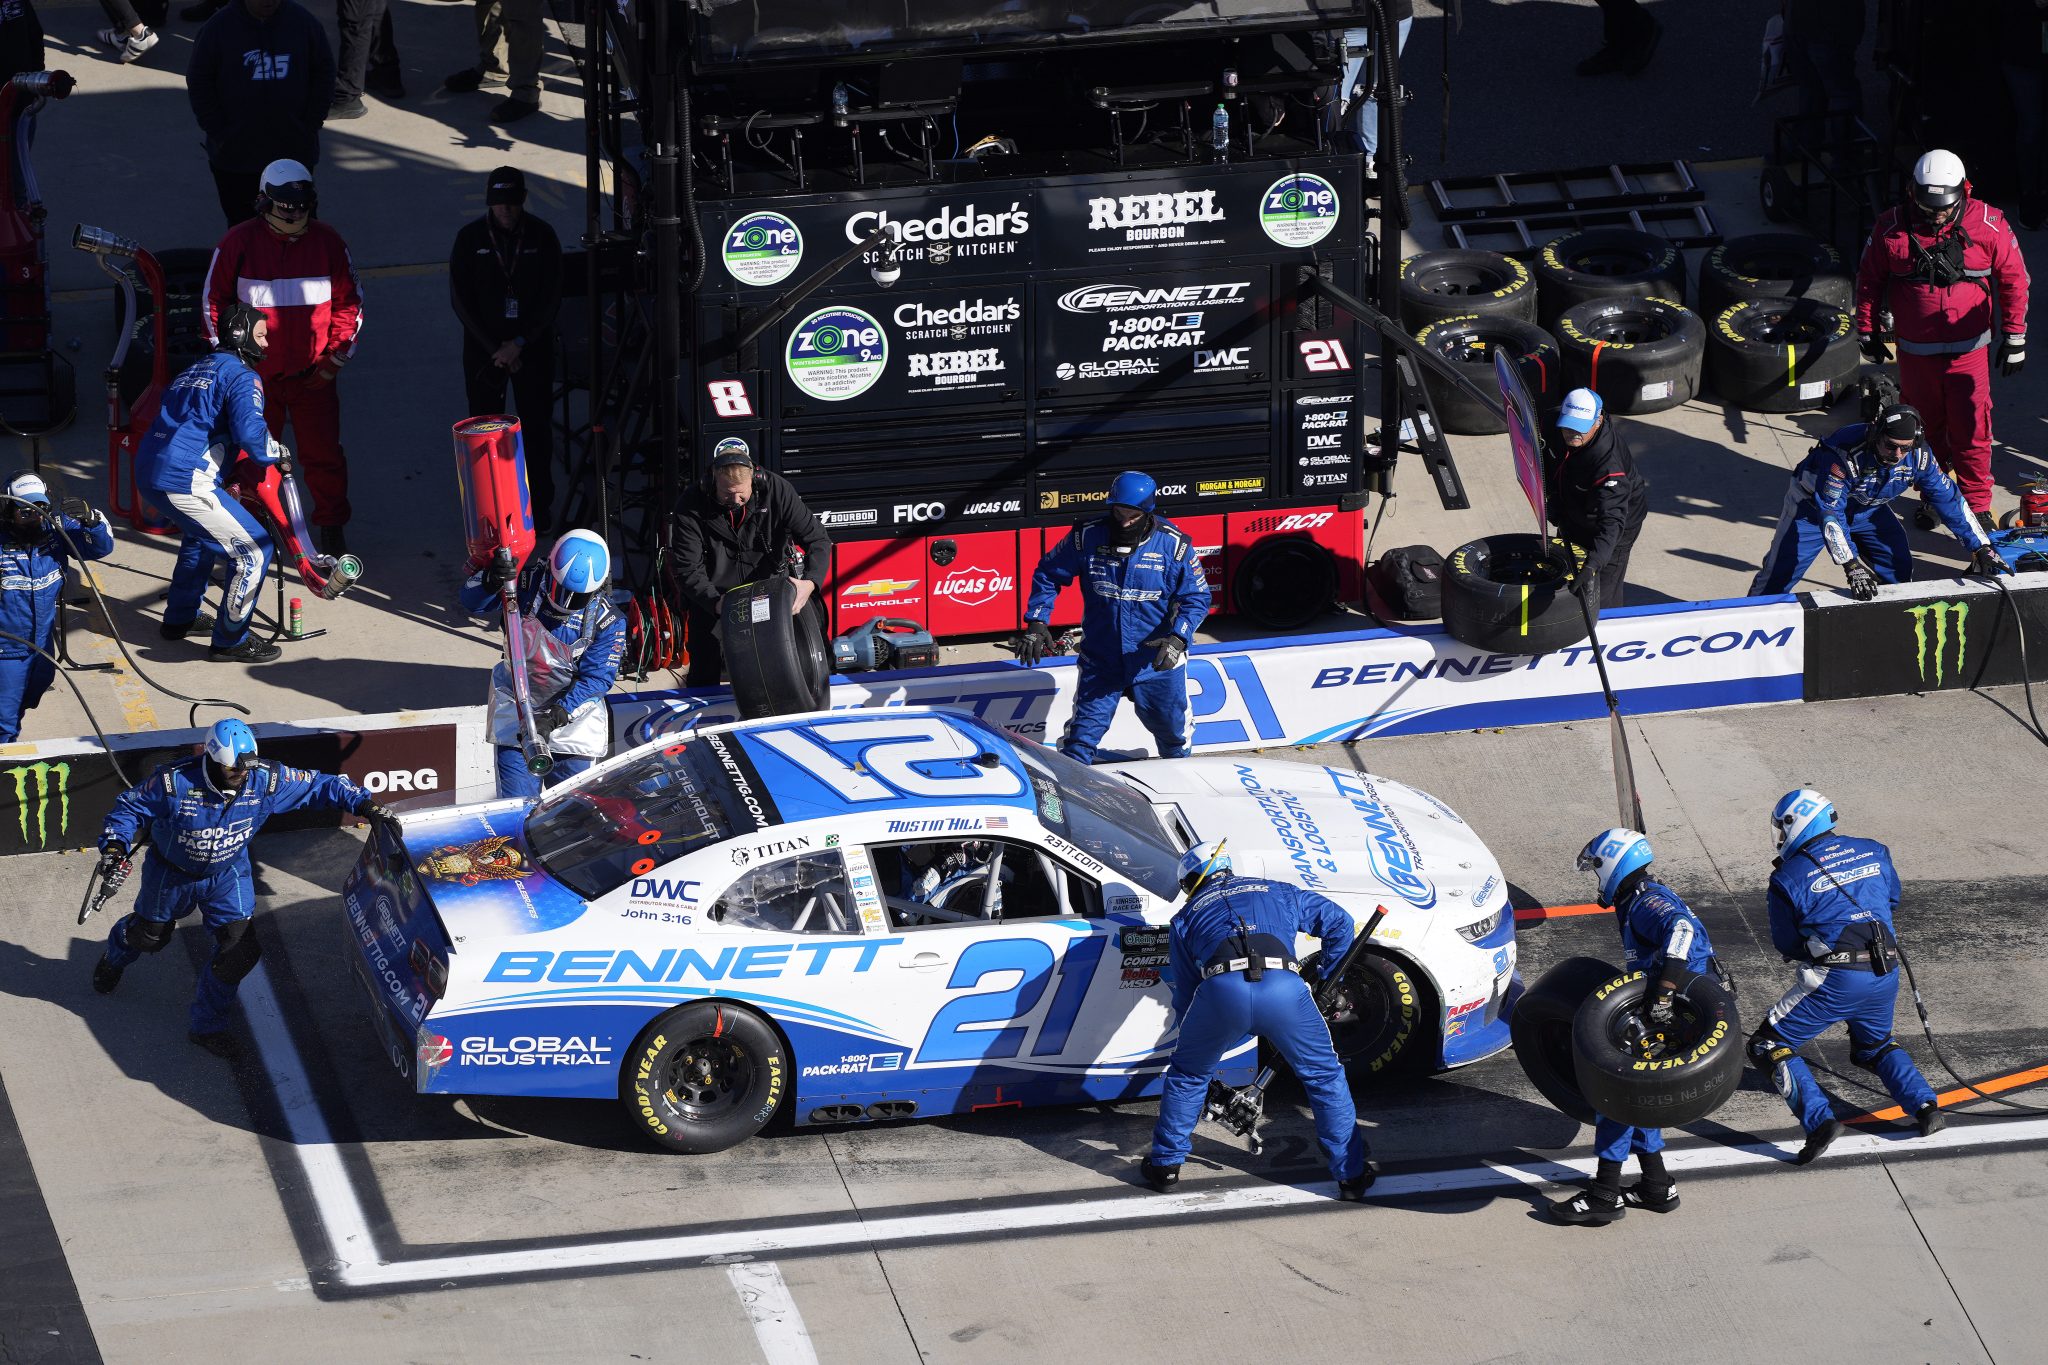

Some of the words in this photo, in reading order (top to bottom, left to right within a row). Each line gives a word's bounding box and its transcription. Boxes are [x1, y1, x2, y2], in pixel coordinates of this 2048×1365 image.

[251, 52, 291, 80] 25
[1089, 189, 1224, 230] REBEL
[845, 202, 1029, 244] Cheddar's
[1126, 226, 1185, 241] BOURBON
[732, 227, 797, 249] zone
[863, 247, 924, 264] SCATCH
[957, 244, 1015, 257] KITCHEN
[22, 266, 31, 279] 3
[1076, 282, 1251, 308] BENNETT
[1105, 301, 1188, 313] TRANSPORTATION
[1196, 297, 1245, 306] LOGISTICS
[894, 297, 1020, 327] Cheddar's
[798, 325, 879, 354] zone
[906, 328, 948, 340] SCRATCH
[970, 324, 1011, 335] KITCHEN
[1102, 330, 1206, 352] PACK-RAT
[908, 347, 1006, 378] REBEL
[1079, 357, 1160, 372] GLOBAL
[1194, 346, 1250, 368] DWC
[1300, 339, 1352, 373] 21
[935, 373, 977, 386] BOURBON
[1079, 366, 1160, 379] INDUSTRIAL
[707, 380, 753, 417] 8
[121, 435, 130, 447] 4
[1307, 433, 1342, 447] DWC
[1310, 453, 1351, 462] GLOBAL
[1199, 481, 1227, 491] MORGAN
[1234, 479, 1262, 489] MORGAN
[1316, 472, 1348, 483] TITAN
[1060, 491, 1110, 503] BETMGM
[1162, 484, 1187, 496] OZK
[831, 511, 874, 523] BOURBON
[893, 501, 946, 523] FICO
[963, 502, 1000, 515] LUCAS
[1002, 500, 1021, 512] OIL
[1274, 512, 1333, 531] RCR
[933, 576, 984, 596] LUCAS
[988, 575, 1013, 592] OIL
[841, 597, 921, 609] CHEVROLET
[1311, 627, 1796, 689] BENNETTIG.COM
[743, 712, 1030, 805] 21
[363, 768, 438, 793] ORG
[706, 734, 770, 827] BENNETTIG.COM
[675, 768, 720, 840] CHEVROLET
[1792, 797, 1819, 818] 21
[886, 818, 946, 834] AUSTIN
[945, 816, 983, 832] HILL
[1233, 763, 1328, 890] TRANSPORTATION
[1270, 788, 1331, 856] LOGISTICS
[1322, 765, 1427, 890] BENNETT
[754, 835, 811, 858] TITAN
[1600, 840, 1625, 859] 21
[631, 879, 701, 903] DWC
[620, 908, 658, 921] John
[661, 912, 692, 926] 3:16
[346, 892, 410, 1007] BENNETTIG.COM
[482, 937, 905, 983] BENNETT
[1120, 979, 1155, 990] MSD
[1596, 971, 1642, 1000] EAGLE
[911, 934, 1109, 1064] 21
[1447, 997, 1486, 1018] ARP
[460, 1036, 612, 1053] GLOBAL
[1633, 1020, 1729, 1071] GOODYEAR
[460, 1053, 611, 1066] INDUSTRIAL
[803, 1062, 868, 1078] PACK-RAT
[840, 1055, 869, 1064] 1-800-
[634, 1034, 668, 1136] GOODYEAR
[767, 1056, 781, 1109] EAGLE
